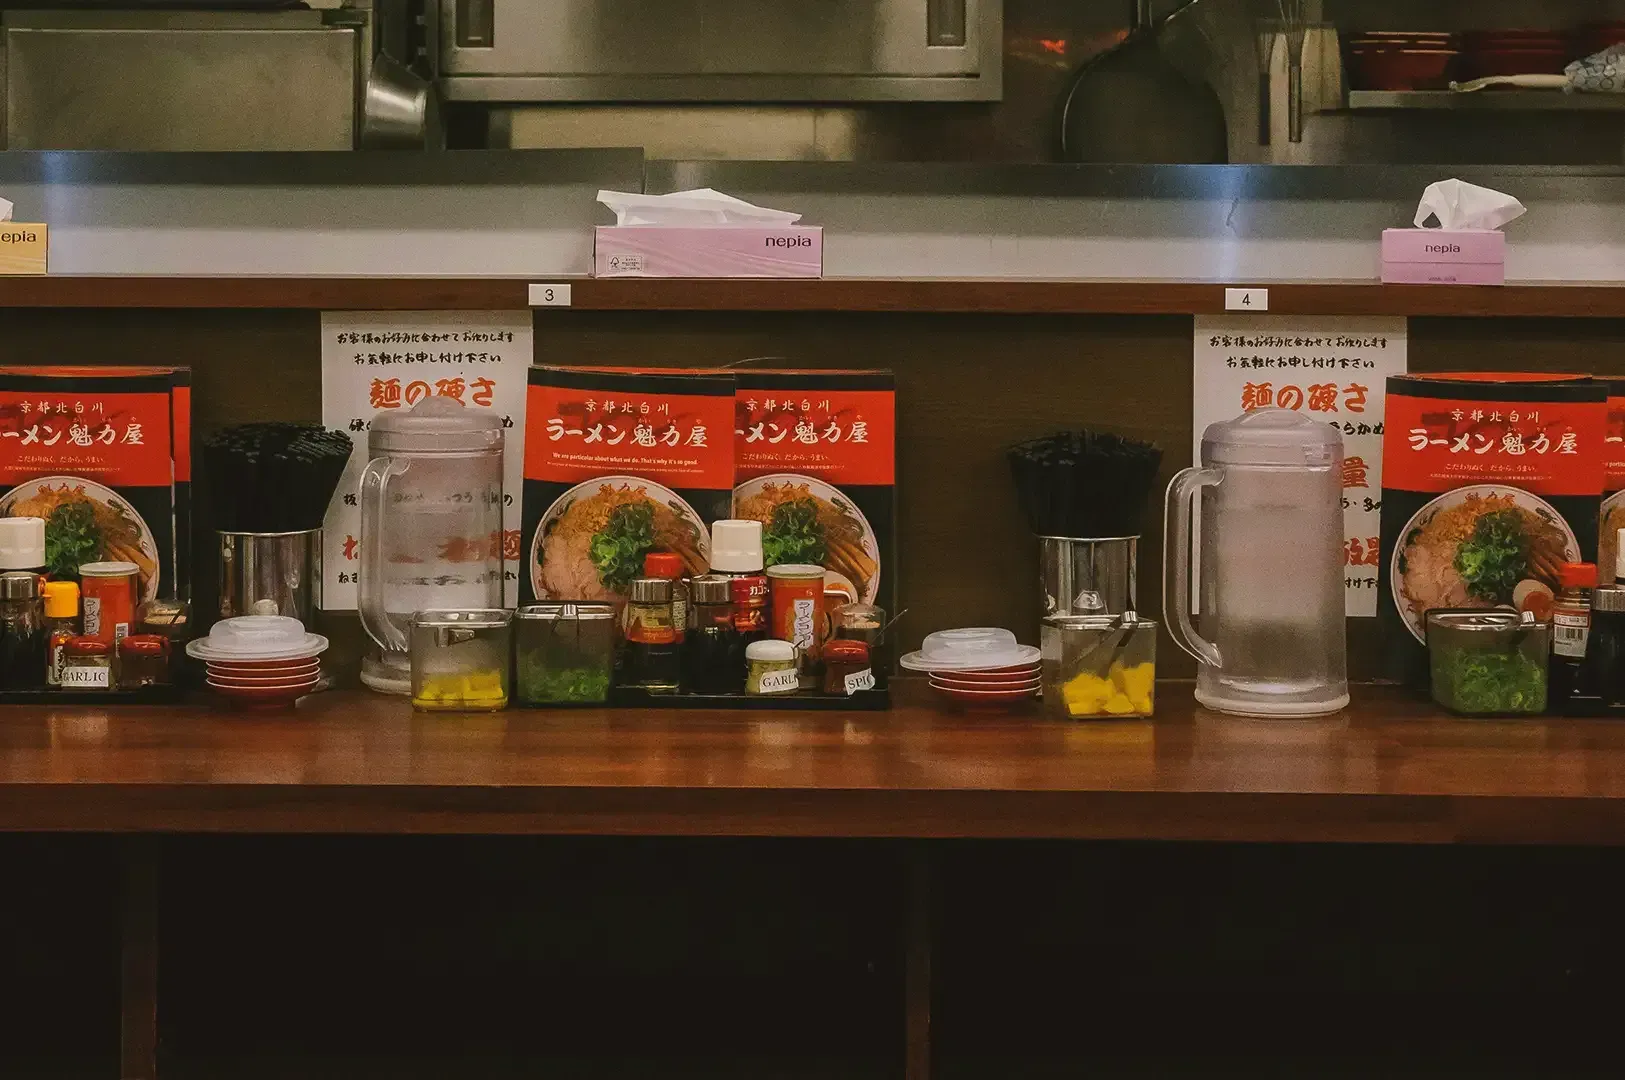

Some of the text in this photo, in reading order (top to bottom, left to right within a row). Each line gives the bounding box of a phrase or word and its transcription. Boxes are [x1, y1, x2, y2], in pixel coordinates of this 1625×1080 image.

[0, 231, 37, 244] epia
[765, 235, 812, 249] nepia
[1425, 243, 1461, 254] nepia
[545, 288, 554, 301] 3
[1242, 293, 1251, 306] 4
[1241, 382, 1369, 413] 麺の硬さ
[20, 401, 104, 414] 京都北白川
[584, 398, 669, 416] 京都北白川
[746, 399, 829, 412] 京都北白川
[1451, 408, 1540, 424] 京都北白川
[1, 424, 144, 446] ーメン魁力屋
[735, 421, 869, 444] ーメン魁力屋
[656, 458, 667, 466] why
